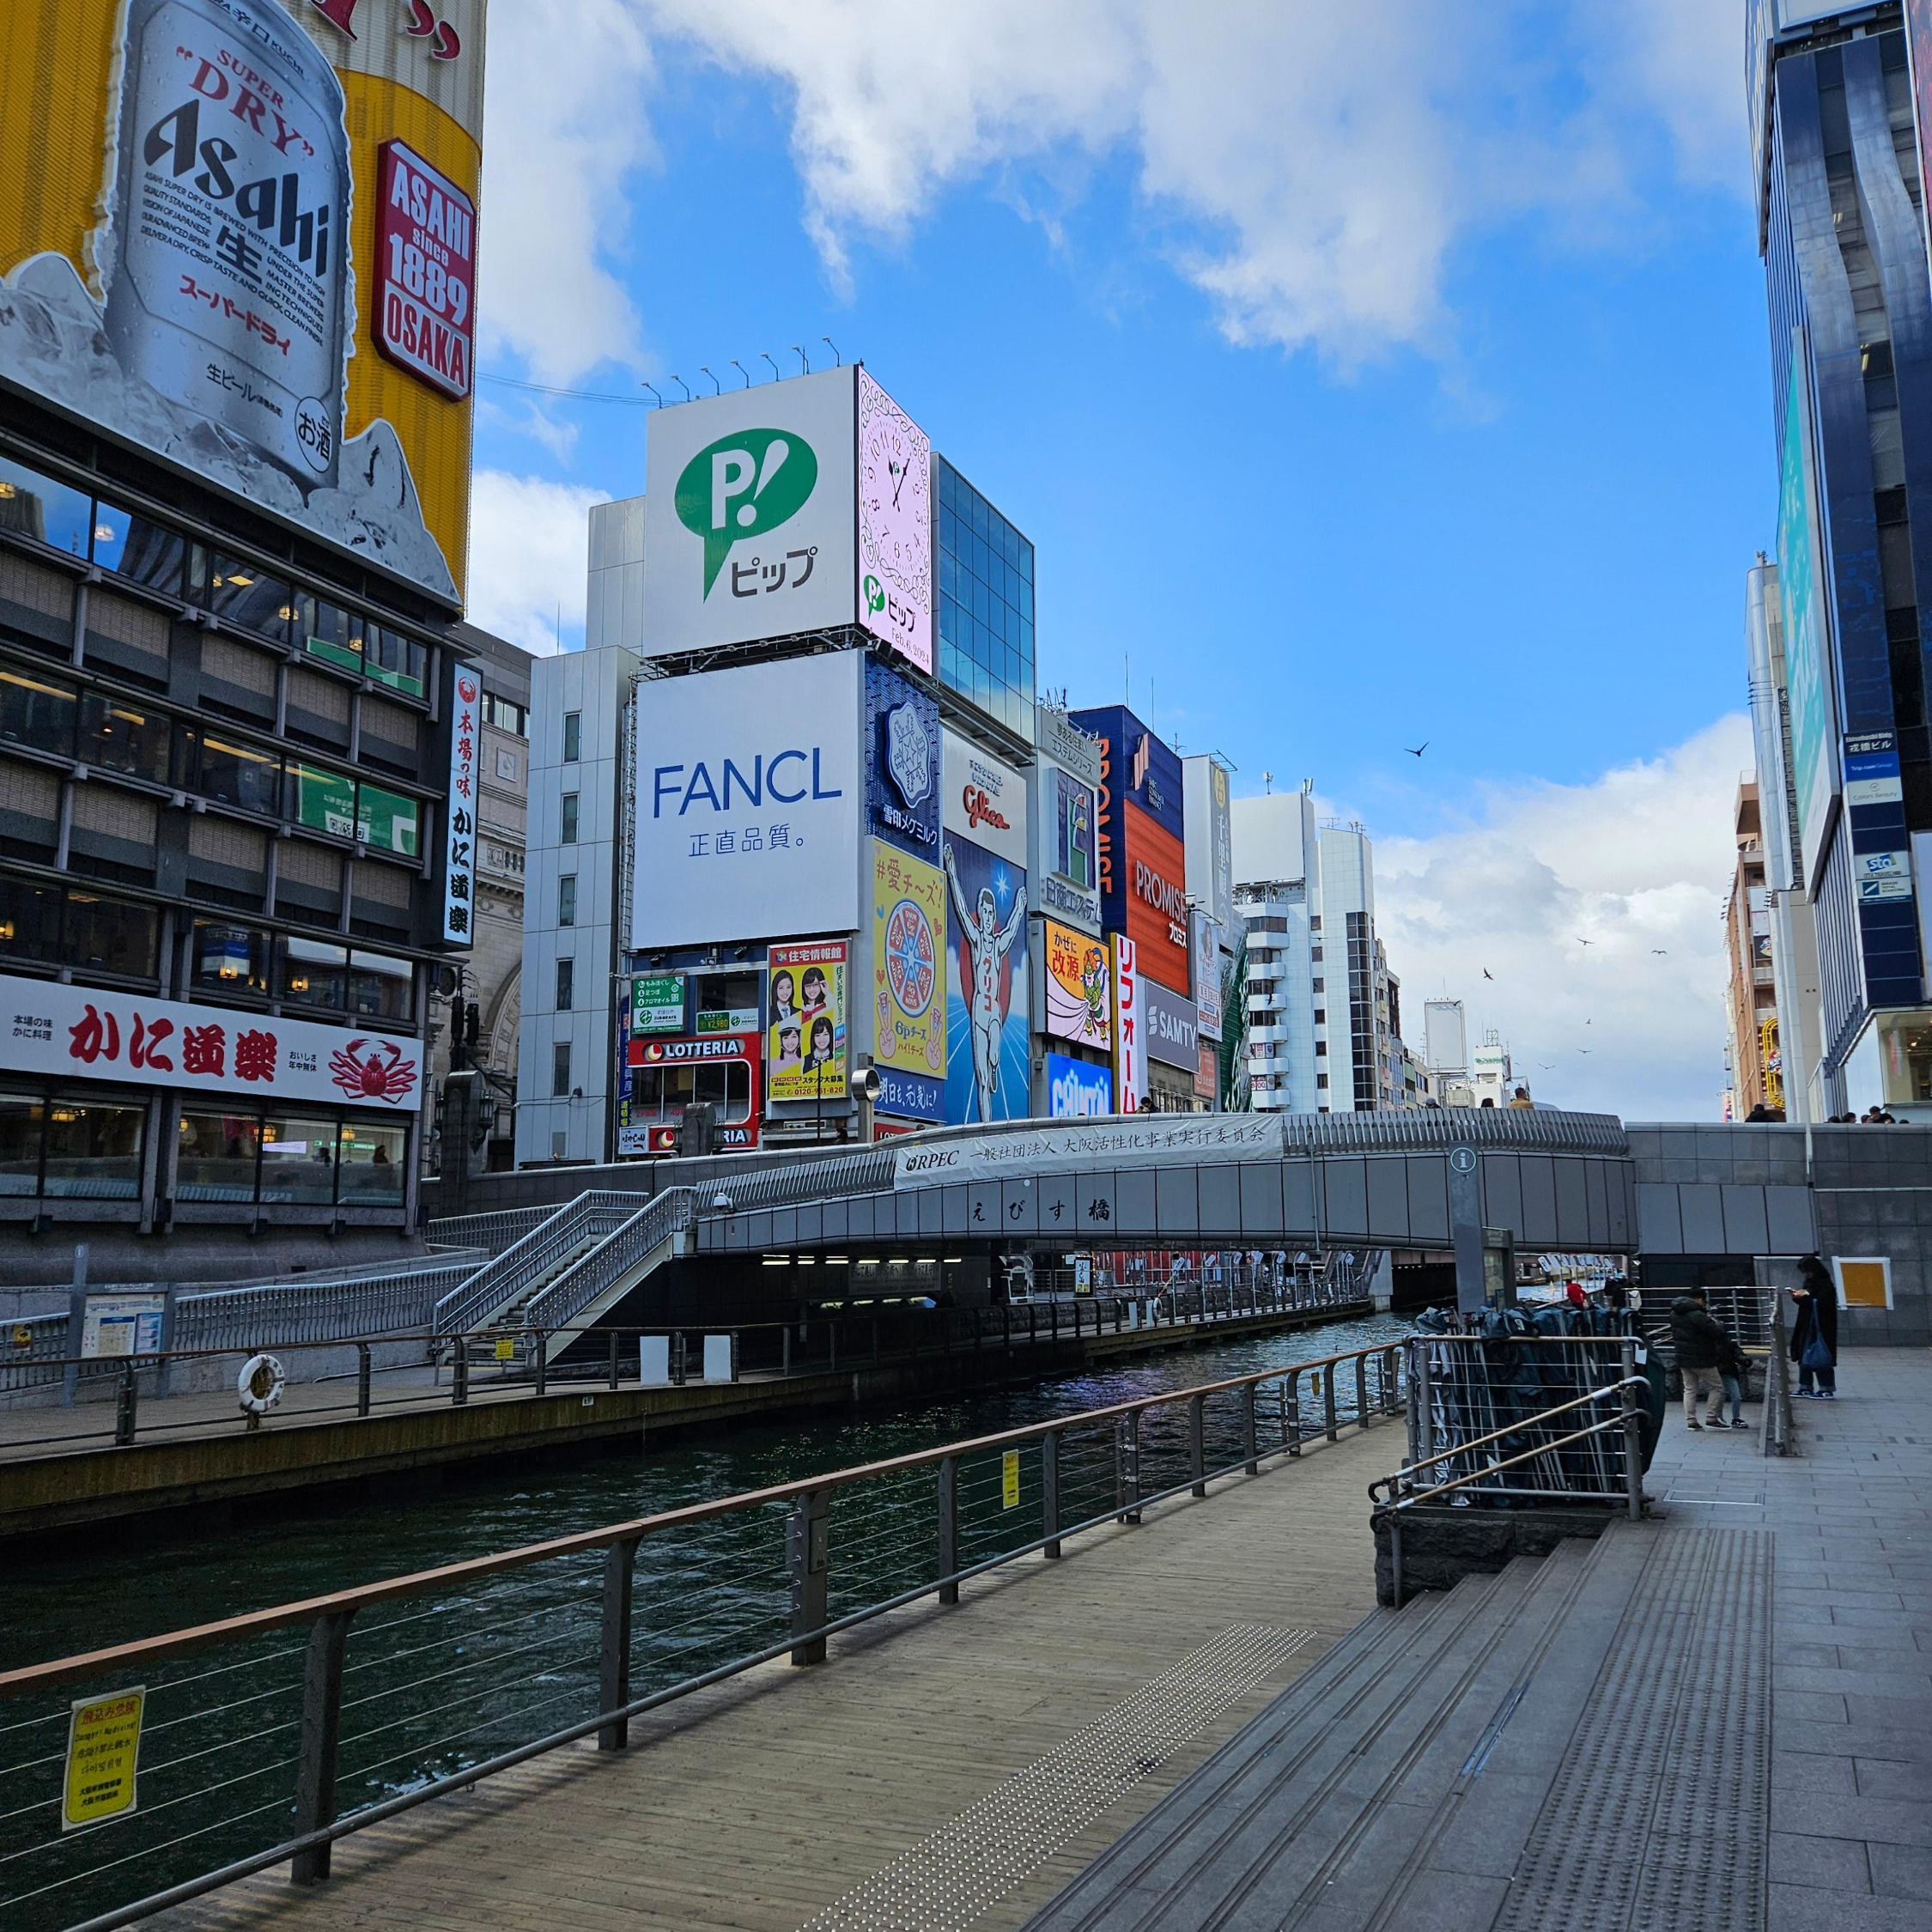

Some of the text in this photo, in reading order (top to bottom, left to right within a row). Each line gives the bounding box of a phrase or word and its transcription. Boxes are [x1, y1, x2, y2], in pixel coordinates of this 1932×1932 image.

[270, 39, 304, 75] KUCHI
[216, 49, 284, 112] SUPER
[143, 99, 330, 279] Asahi
[391, 161, 471, 262] ASAHI
[143, 185, 169, 201] QUALITY
[267, 256, 293, 281] UNDER
[294, 276, 307, 293] THE
[163, 207, 173, 217] OF
[173, 212, 210, 237] JAPANESE
[266, 270, 297, 297] MASTER
[164, 179, 186, 195] SUPER
[187, 191, 204, 205] DRY
[204, 201, 212, 210] IS
[213, 207, 246, 232] BREWED
[247, 228, 268, 248] WITH
[269, 245, 303, 276] PRECISION
[304, 273, 313, 284] TO
[312, 281, 325, 297] HIGH
[216, 225, 263, 284] 生
[412, 228, 449, 267] since
[141, 225, 167, 243] DELIVER
[190, 248, 213, 264] CRISP
[214, 262, 239, 282] TASTE
[239, 277, 258, 295] AND
[283, 309, 306, 331] CLEAN
[154, 216, 188, 239] ADVANCED
[265, 283, 281, 298] ING
[281, 293, 324, 334] TECHNIQUES
[389, 232, 468, 327] 1889
[179, 274, 291, 356] スーパードライ
[387, 291, 465, 389] OSAKA
[206, 362, 257, 402] 生ビール
[299, 411, 331, 462] お酒
[871, 440, 882, 459] 10
[880, 431, 890, 450] 11
[891, 434, 902, 457] 12
[868, 466, 878, 483] 9
[872, 499, 881, 513] 8
[882, 526, 890, 538] 7
[894, 541, 901, 560] 6
[914, 533, 921, 548] 4
[732, 546, 818, 598] ピップ
[905, 544, 913, 562] 5
[888, 593, 916, 633] ピップ
[456, 710, 475, 800] 本場の味
[1052, 739, 1093, 776] エステムシリーズ
[1850, 741, 1892, 753] 戎橋ビル
[653, 747, 842, 818] FANCL
[883, 804, 937, 846] 雪印メグミルク
[963, 785, 1010, 829] Glico
[449, 806, 472, 935] かに道楽
[1869, 856, 1893, 870] sta
[1136, 860, 1187, 927] PROMISE
[788, 946, 842, 963] 住宅情報館
[1054, 931, 1078, 954] かぜに
[982, 956, 993, 1012] グリコ
[1052, 949, 1080, 981] 改源
[12, 1027, 52, 1042] かに料理
[13, 1014, 53, 1030] 本場の味
[1120, 937, 1136, 1115] リフォーム
[1159, 1011, 1197, 1050] SAMTY
[69, 1004, 278, 1083] かに道楽
[289, 1050, 318, 1063] おいしさ
[666, 1041, 738, 1058] LOTTERIA
[289, 1060, 318, 1072] 年中無休
[970, 1142, 1056, 1162] 一般社団法人
[1063, 1127, 1267, 1153] 大阪活性化事業実行委員会
[972, 1199, 1110, 1223] えびす橋
